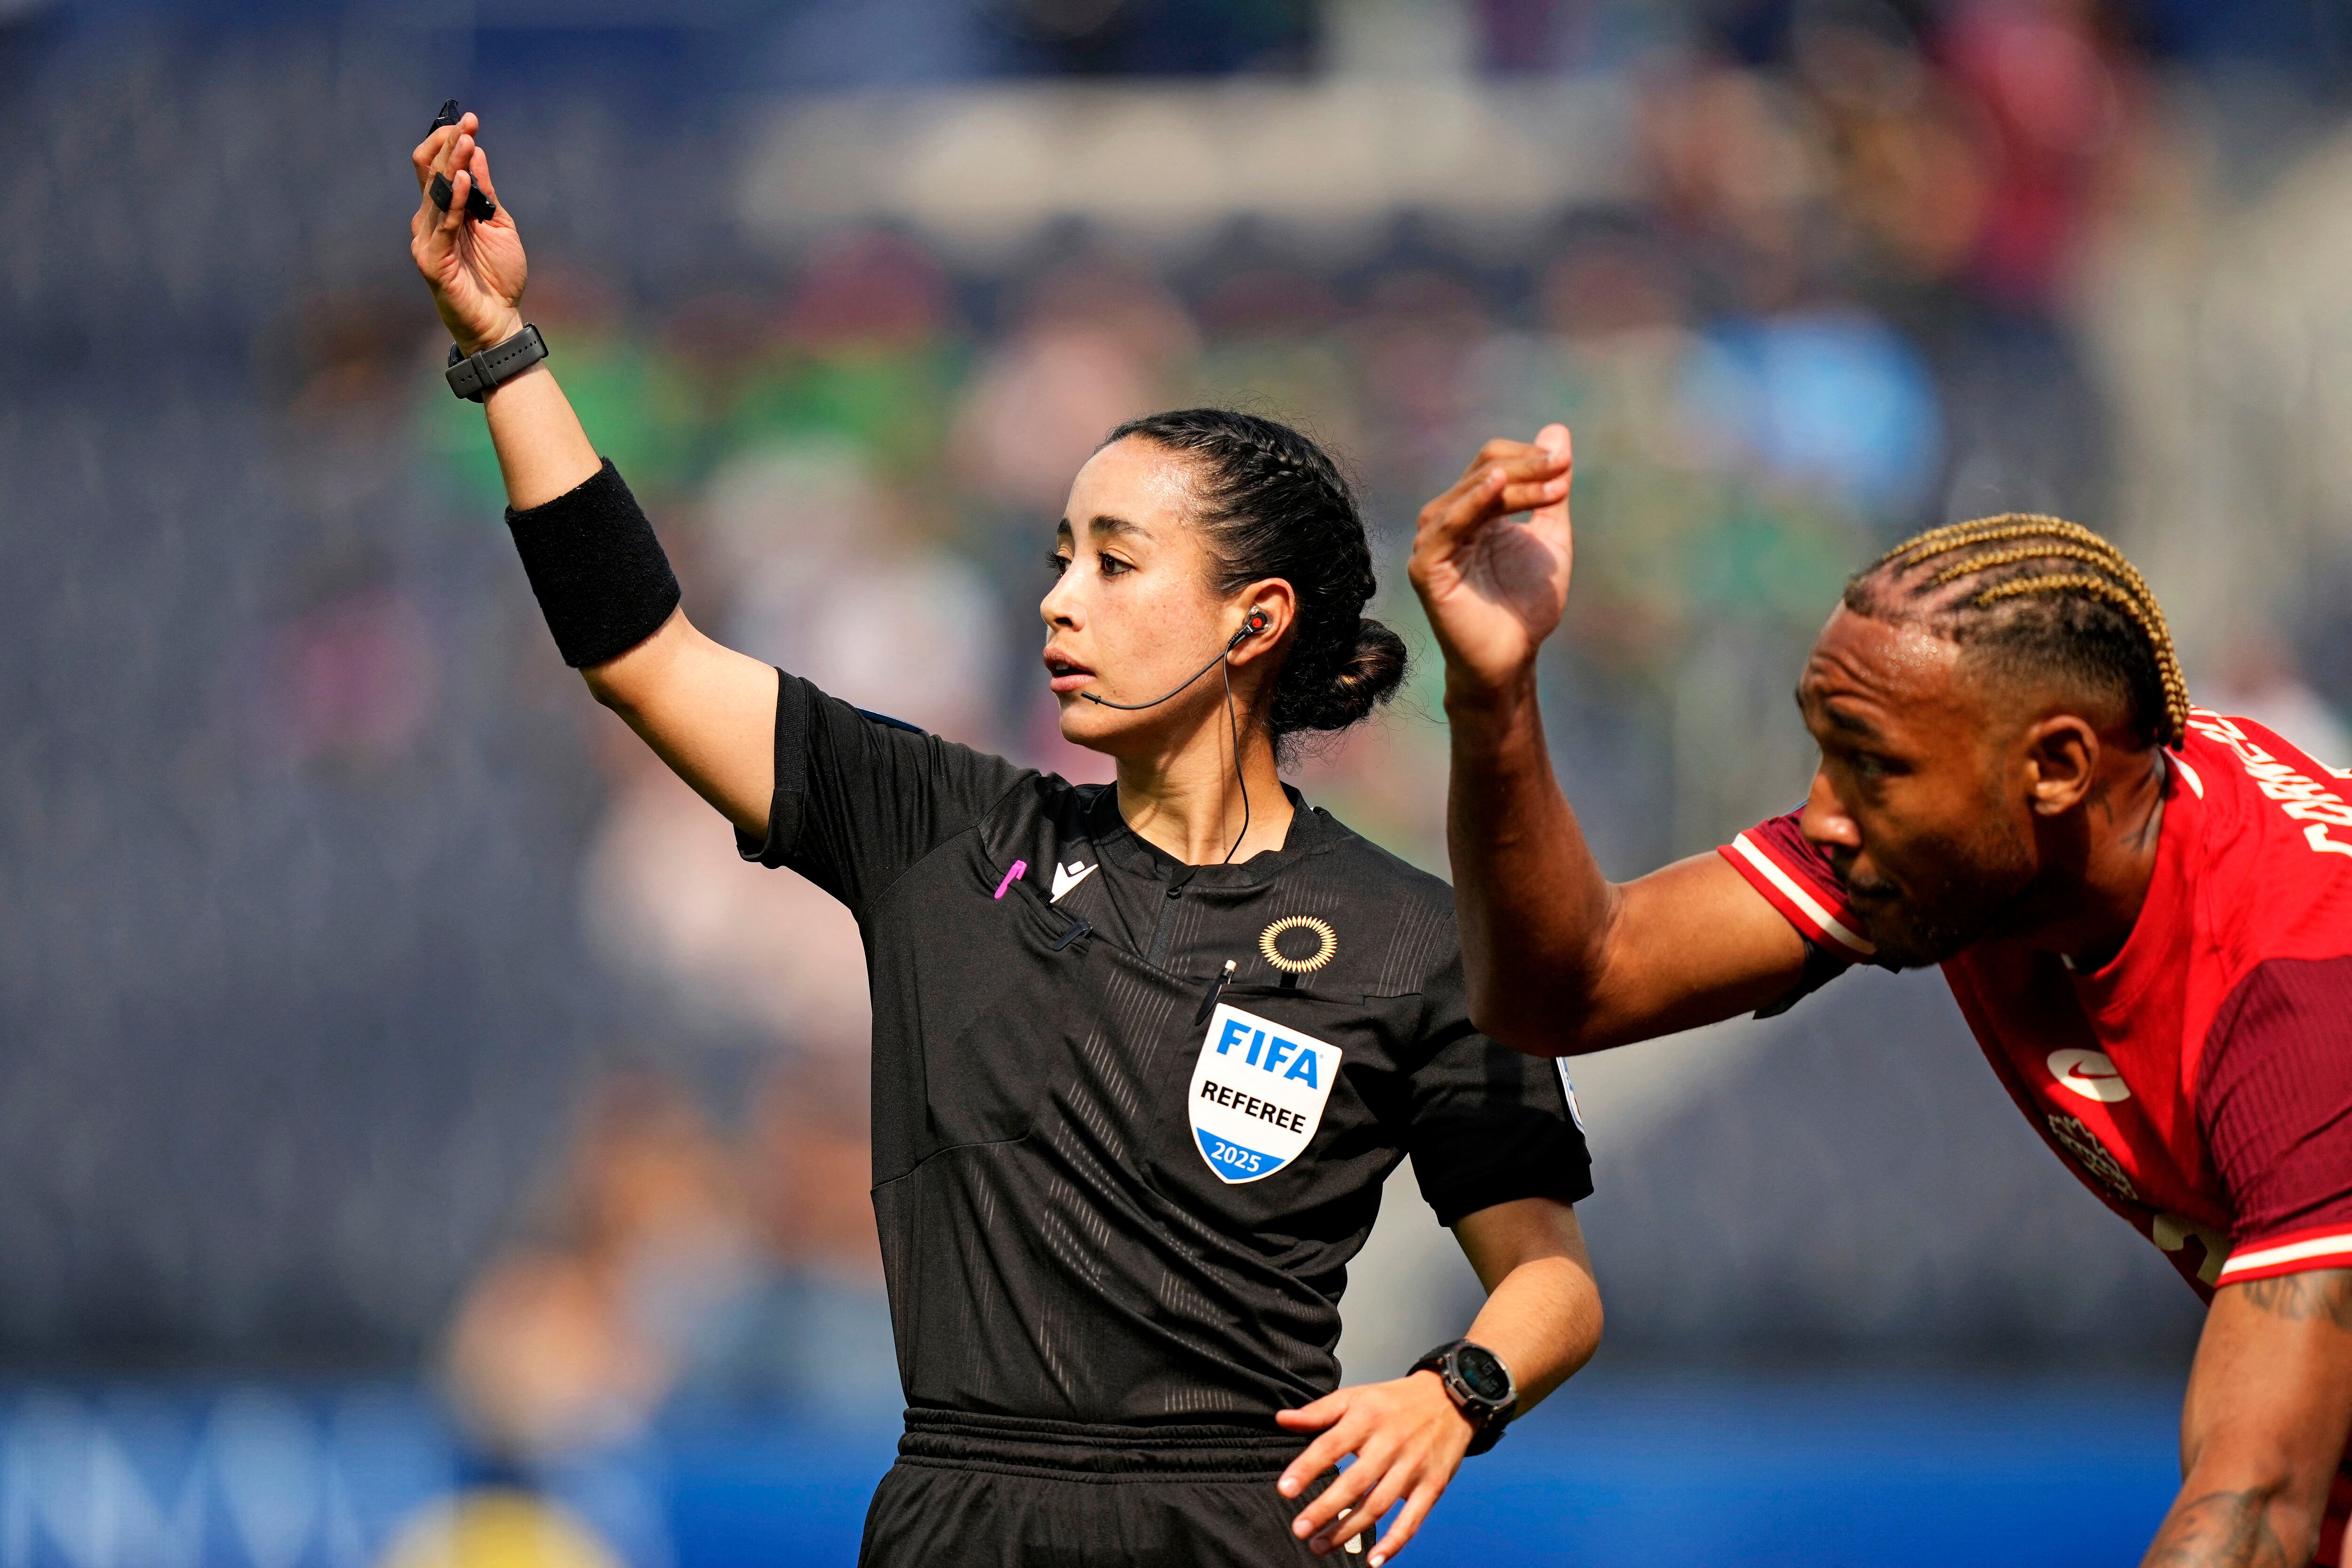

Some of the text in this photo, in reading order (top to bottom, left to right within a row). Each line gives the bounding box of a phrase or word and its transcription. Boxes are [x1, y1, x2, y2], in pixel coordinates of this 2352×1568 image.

[1216, 1019, 1318, 1090] FIFA
[1200, 1080, 1307, 1134] REFEREE
[1210, 1141, 1262, 1172] 2025
